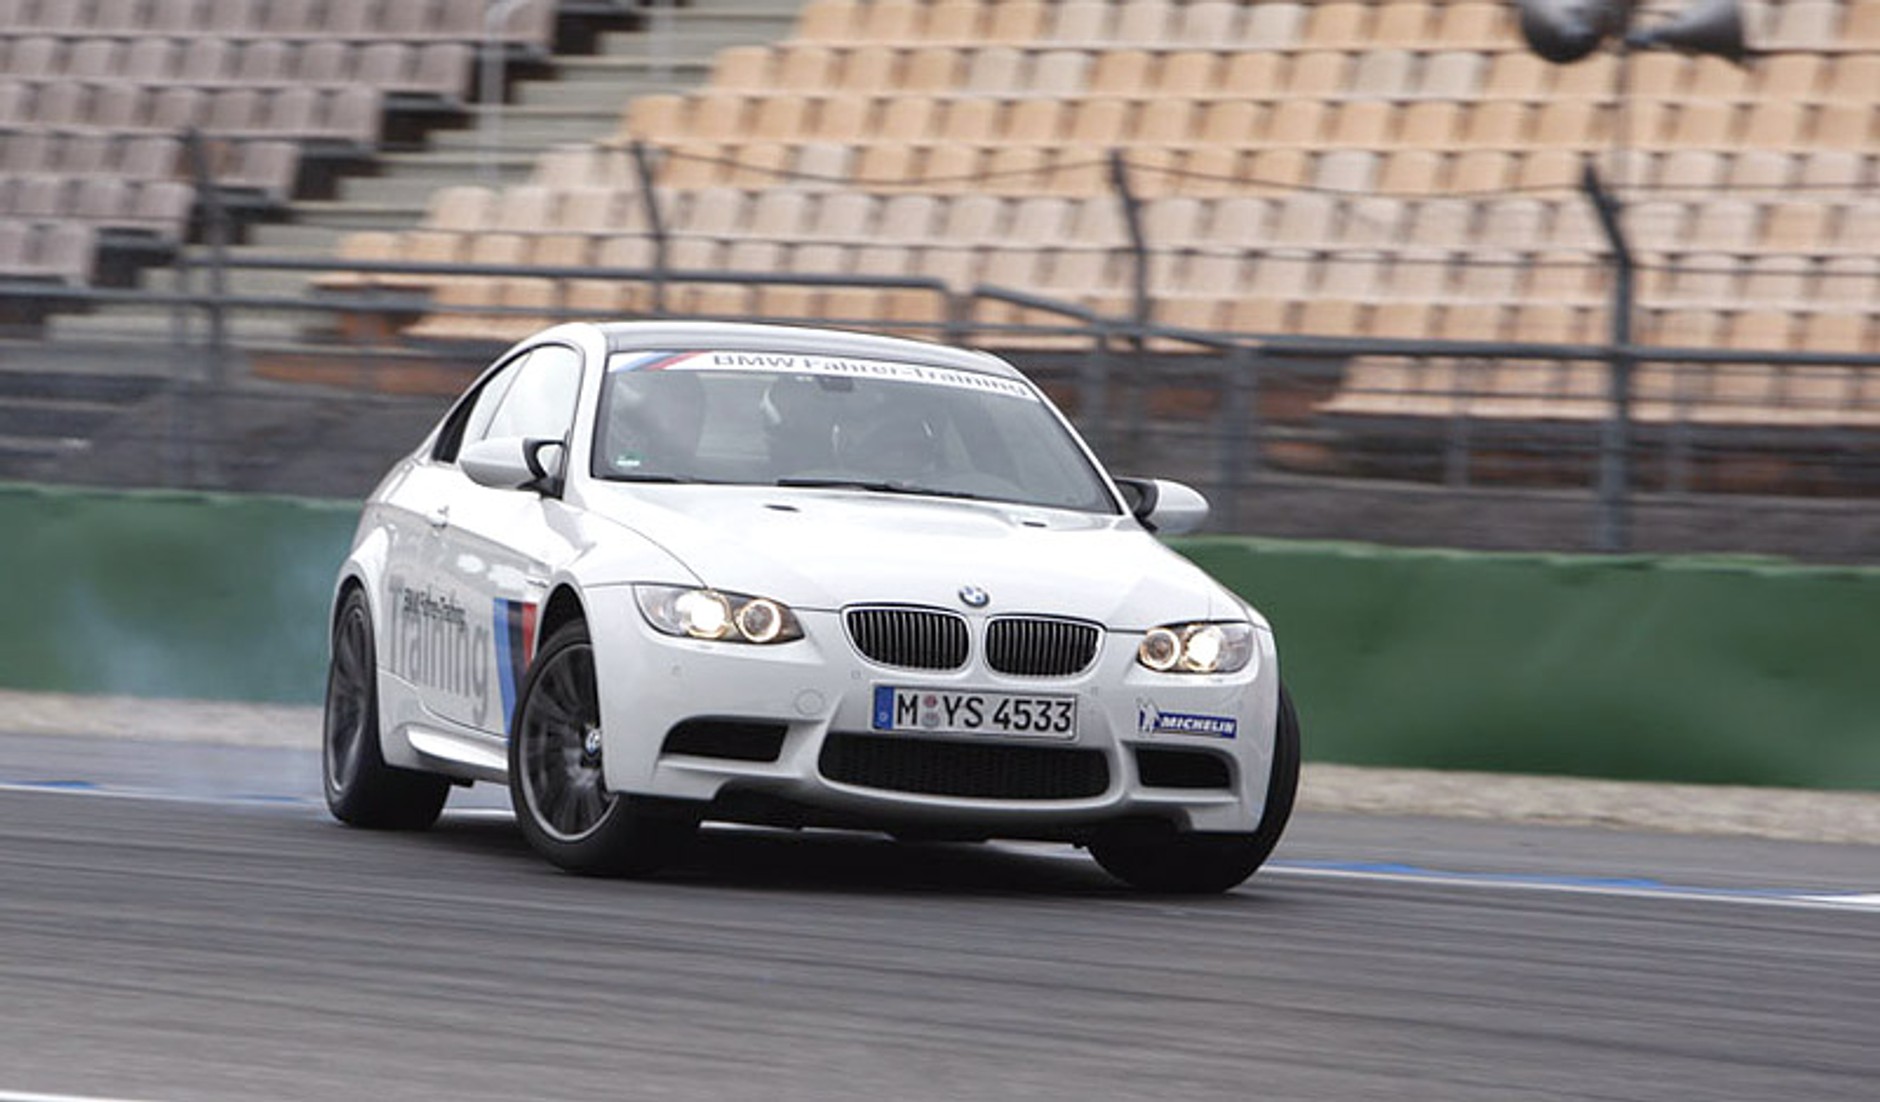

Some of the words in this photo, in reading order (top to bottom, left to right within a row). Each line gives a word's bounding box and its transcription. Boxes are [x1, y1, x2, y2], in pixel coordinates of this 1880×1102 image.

[713, 354, 795, 368] BMW
[803, 358, 1029, 396] Fahrer-Training
[388, 573, 488, 727] Training
[897, 693, 918, 726] M
[941, 696, 984, 728] YS
[993, 698, 1073, 732] 4533
[1160, 716, 1236, 734] MICHELIN
